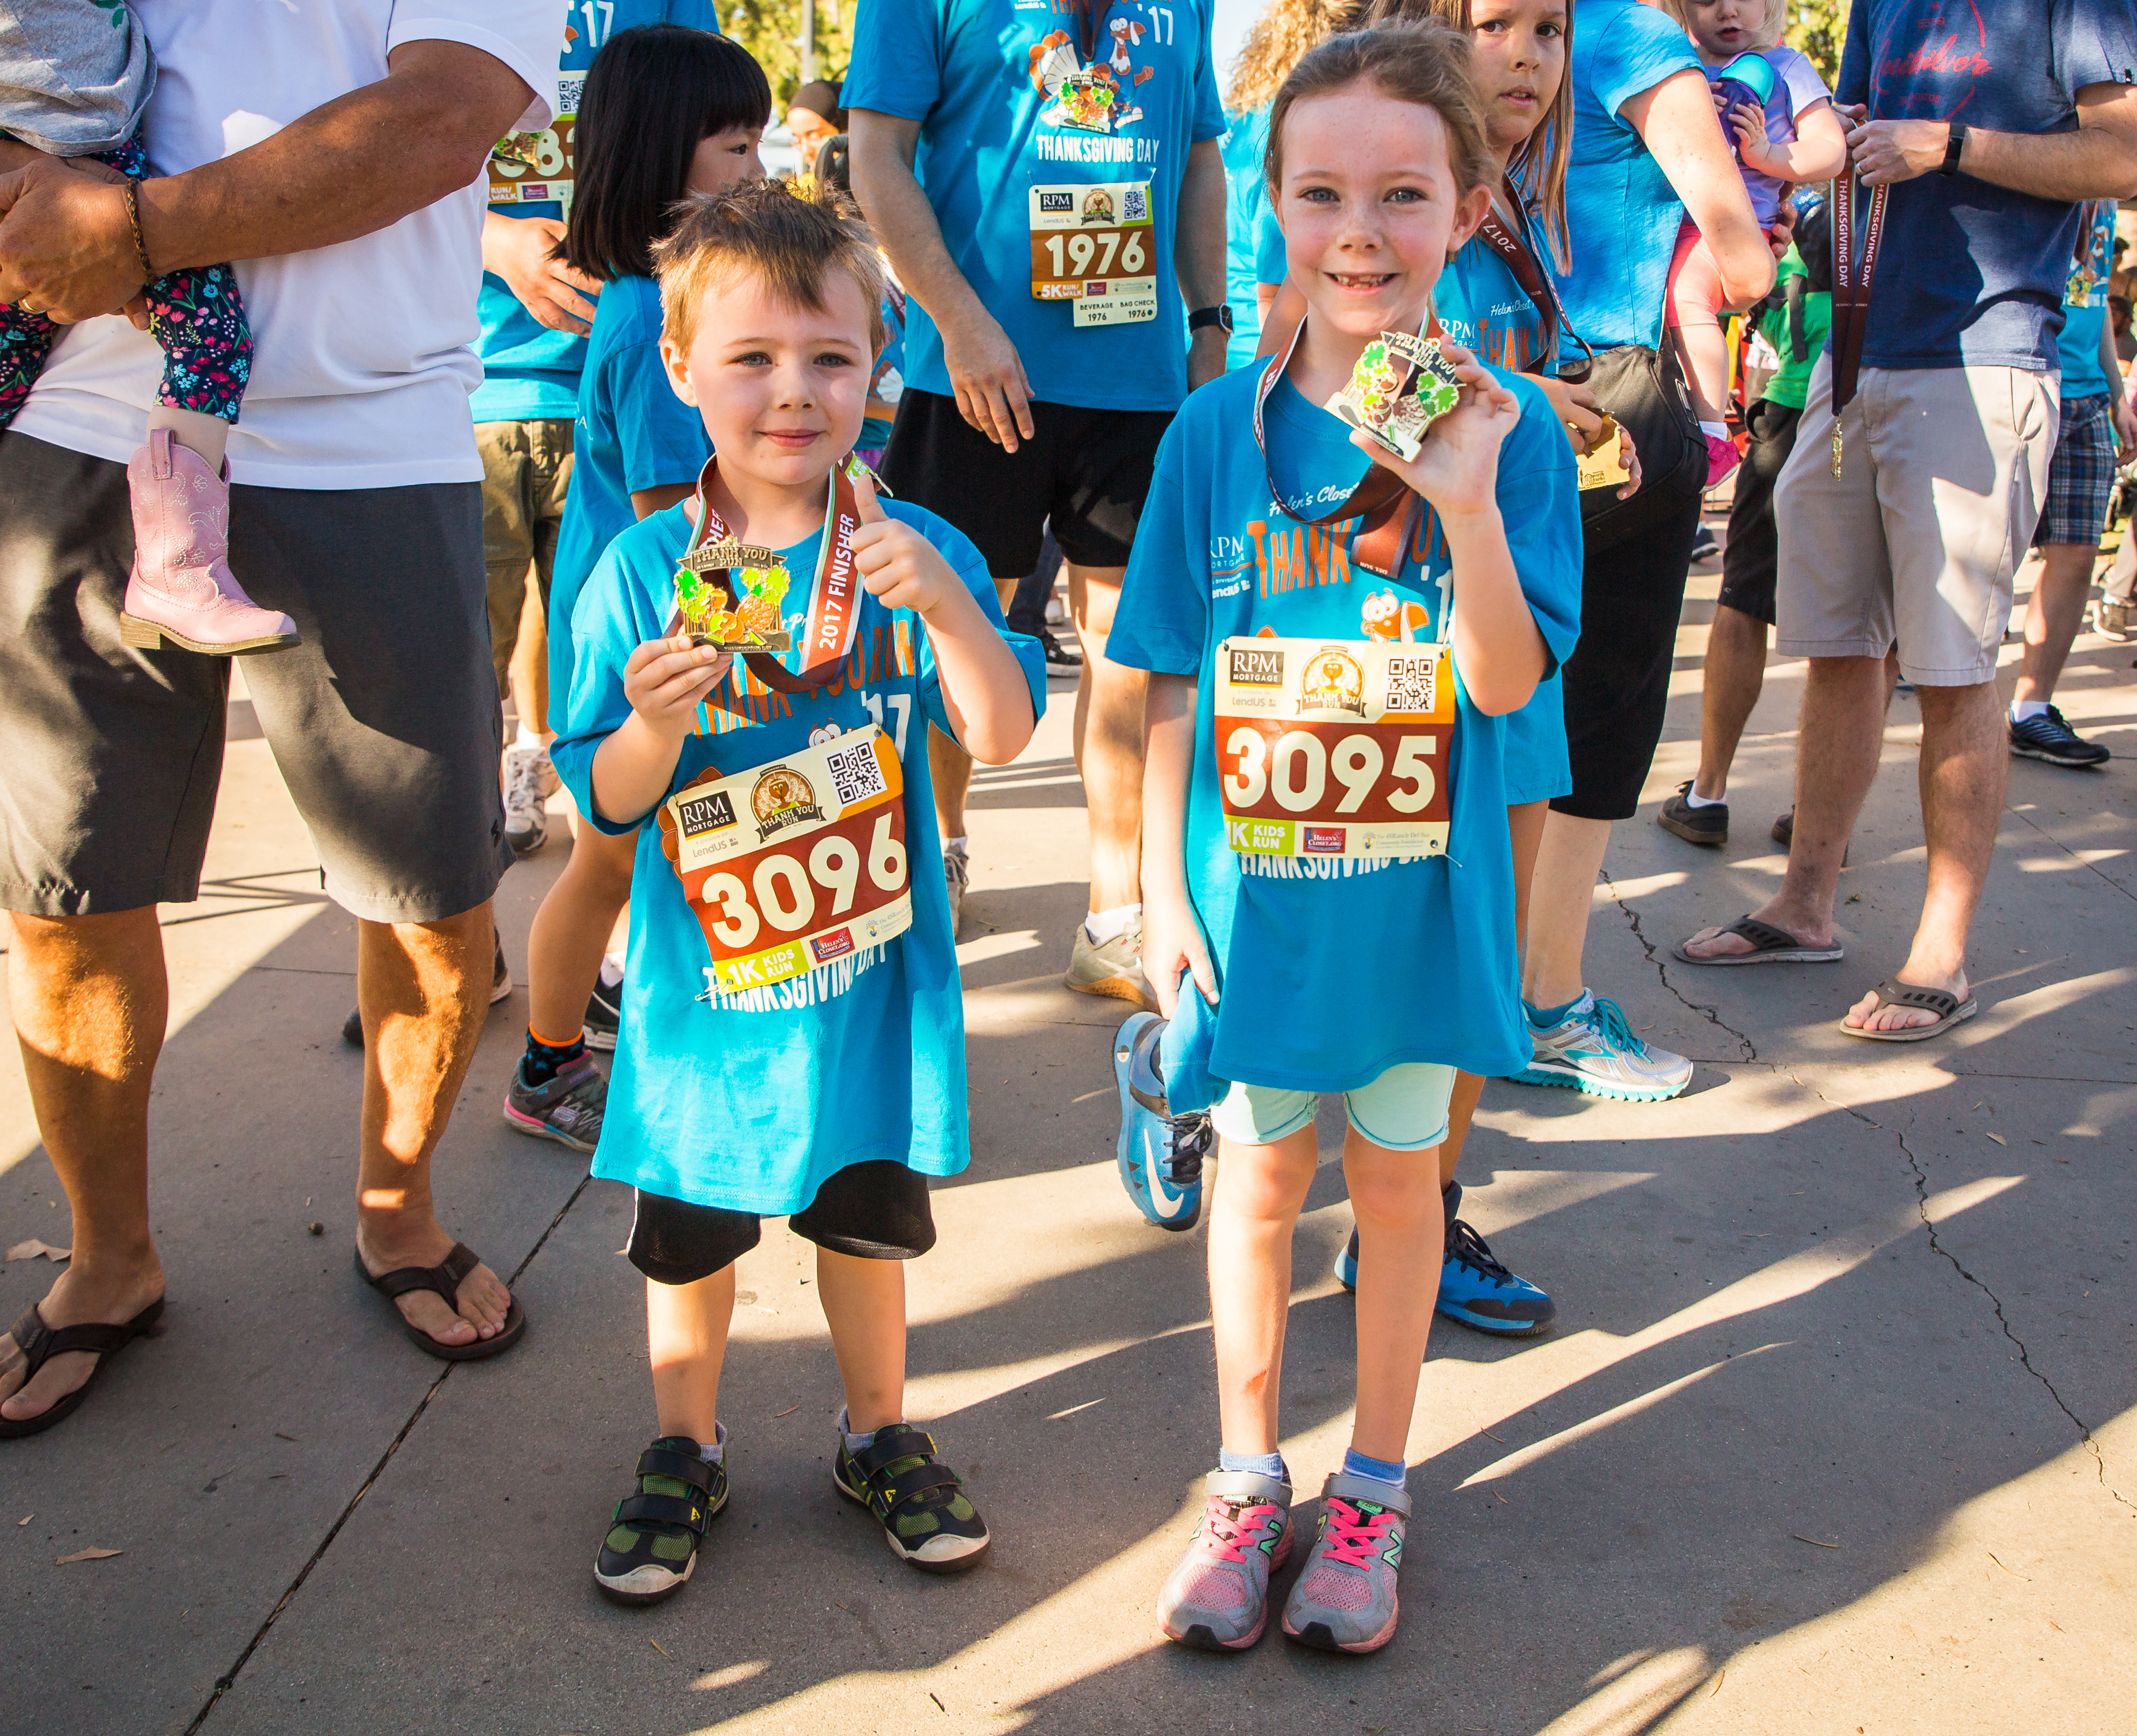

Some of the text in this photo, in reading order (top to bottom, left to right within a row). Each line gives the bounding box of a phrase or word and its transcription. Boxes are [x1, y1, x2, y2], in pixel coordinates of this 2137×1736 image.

[1137, 3, 1174, 46] '17
[1036, 135, 1160, 163] THANKSGIVING DAY
[1042, 195, 1070, 206] RPM
[1865, 183, 1886, 263] HANKSGIVING
[1838, 178, 1849, 288] THANKSGIVING DAY
[1045, 231, 1146, 277] 1976
[1861, 265, 1872, 288] DAY
[1041, 284, 1063, 298] 5K
[1088, 312, 1107, 322] 1976
[1128, 309, 1146, 319] 1976
[1490, 302, 1515, 317] Helen's
[1438, 318, 1475, 339] RPM
[1395, 331, 1456, 375] THANK YOU
[1412, 351, 1434, 369] RUN
[693, 546, 768, 563] THANK YOU
[719, 557, 743, 567] RUN
[1247, 518, 1353, 599] THANK
[819, 513, 855, 650] 2017 FINISHER
[1234, 651, 1279, 674] RPM
[1232, 673, 1279, 683] MORTGAGE
[1232, 696, 1266, 707] LendUS
[1304, 692, 1361, 705] THANK YOU
[1223, 726, 1437, 813] 3095
[682, 796, 728, 825] RPM
[760, 810, 795, 829] THANK
[796, 804, 814, 815] YOU
[687, 815, 731, 834] MORTGAGE
[781, 815, 799, 827] RUN
[1253, 824, 1286, 838] KIDS
[692, 840, 728, 858] LendUS
[1253, 836, 1280, 849] RUN
[702, 811, 908, 949] 3096
[762, 948, 795, 965] KIDS
[727, 958, 765, 986] 1K
[765, 960, 794, 978] RUN
